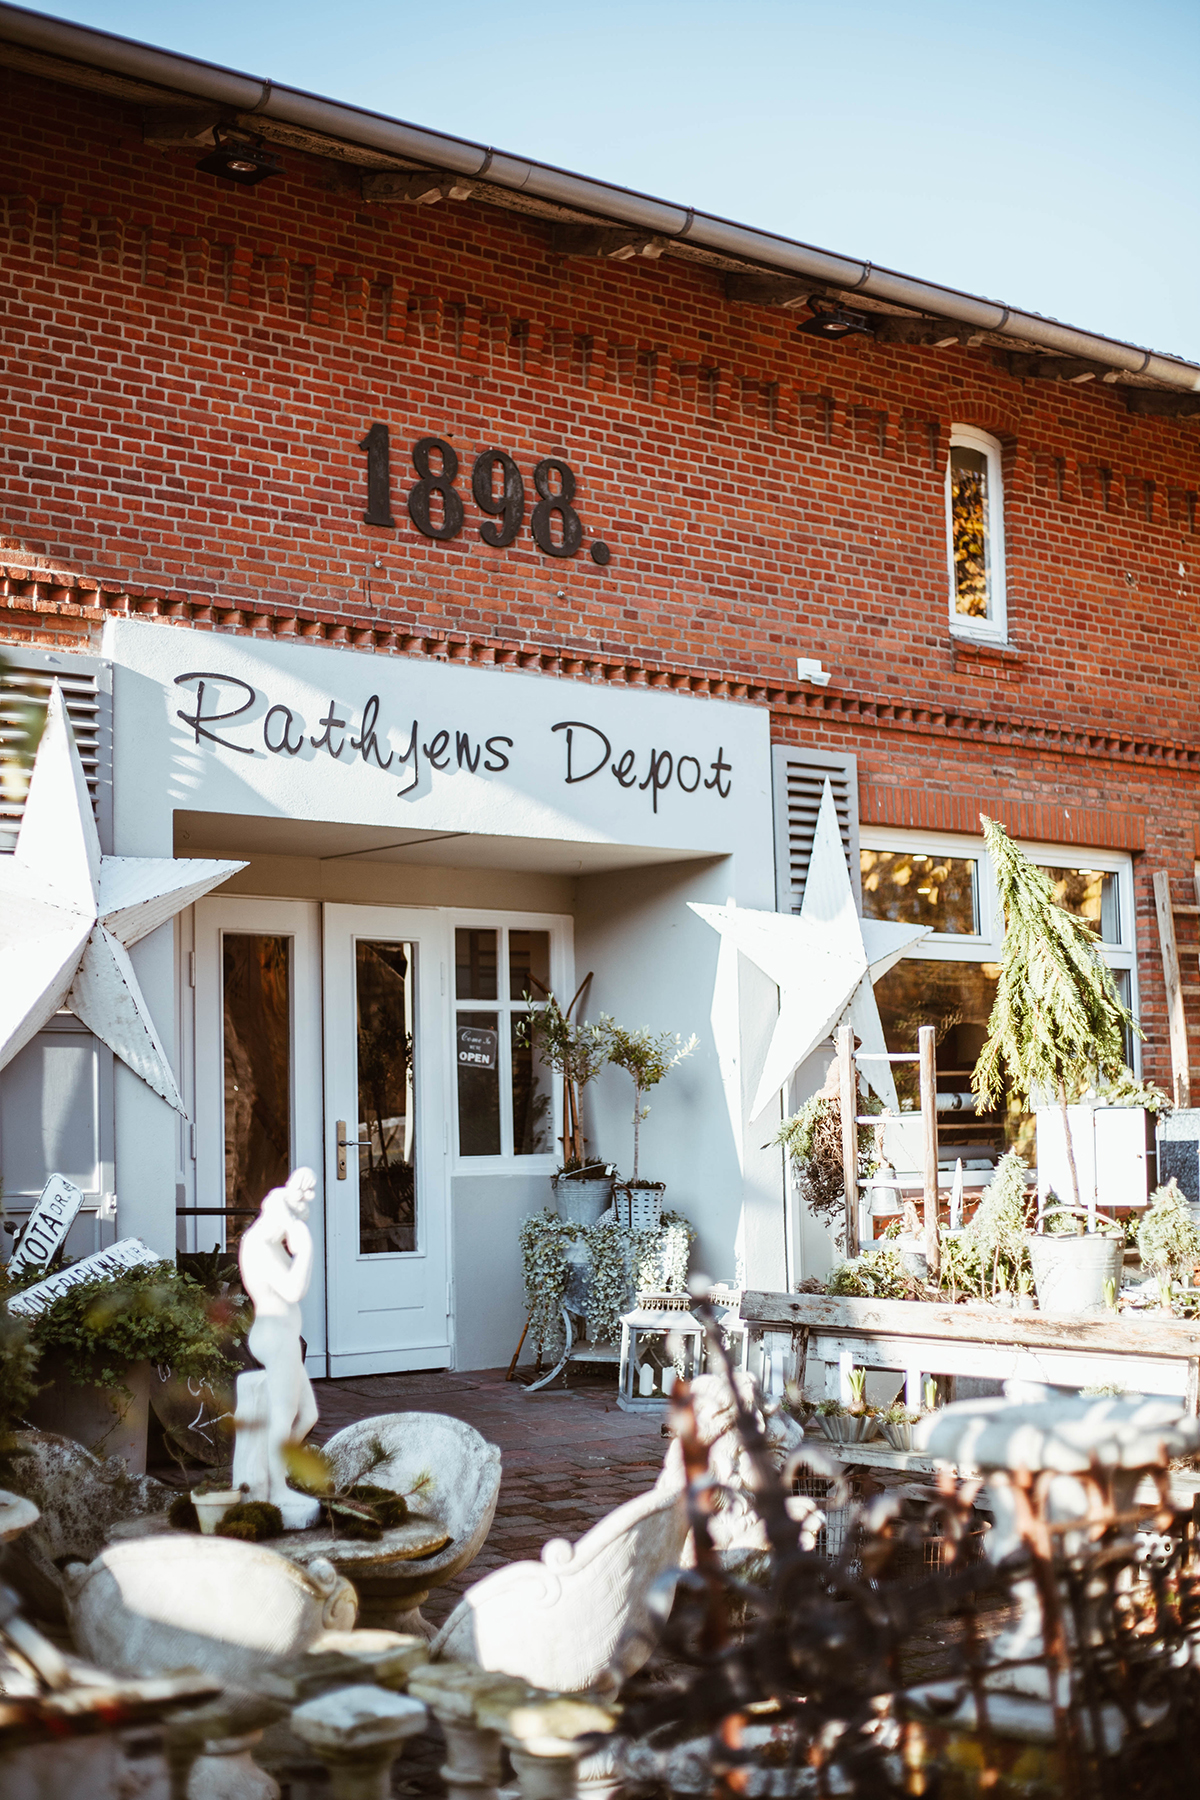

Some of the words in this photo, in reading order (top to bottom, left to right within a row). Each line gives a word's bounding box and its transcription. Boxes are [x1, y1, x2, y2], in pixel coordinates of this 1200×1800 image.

[358, 423, 610, 566] 1898.
[173, 671, 514, 797] Rathjens
[551, 720, 733, 814] Depot
[459, 1051, 490, 1064] OPEN
